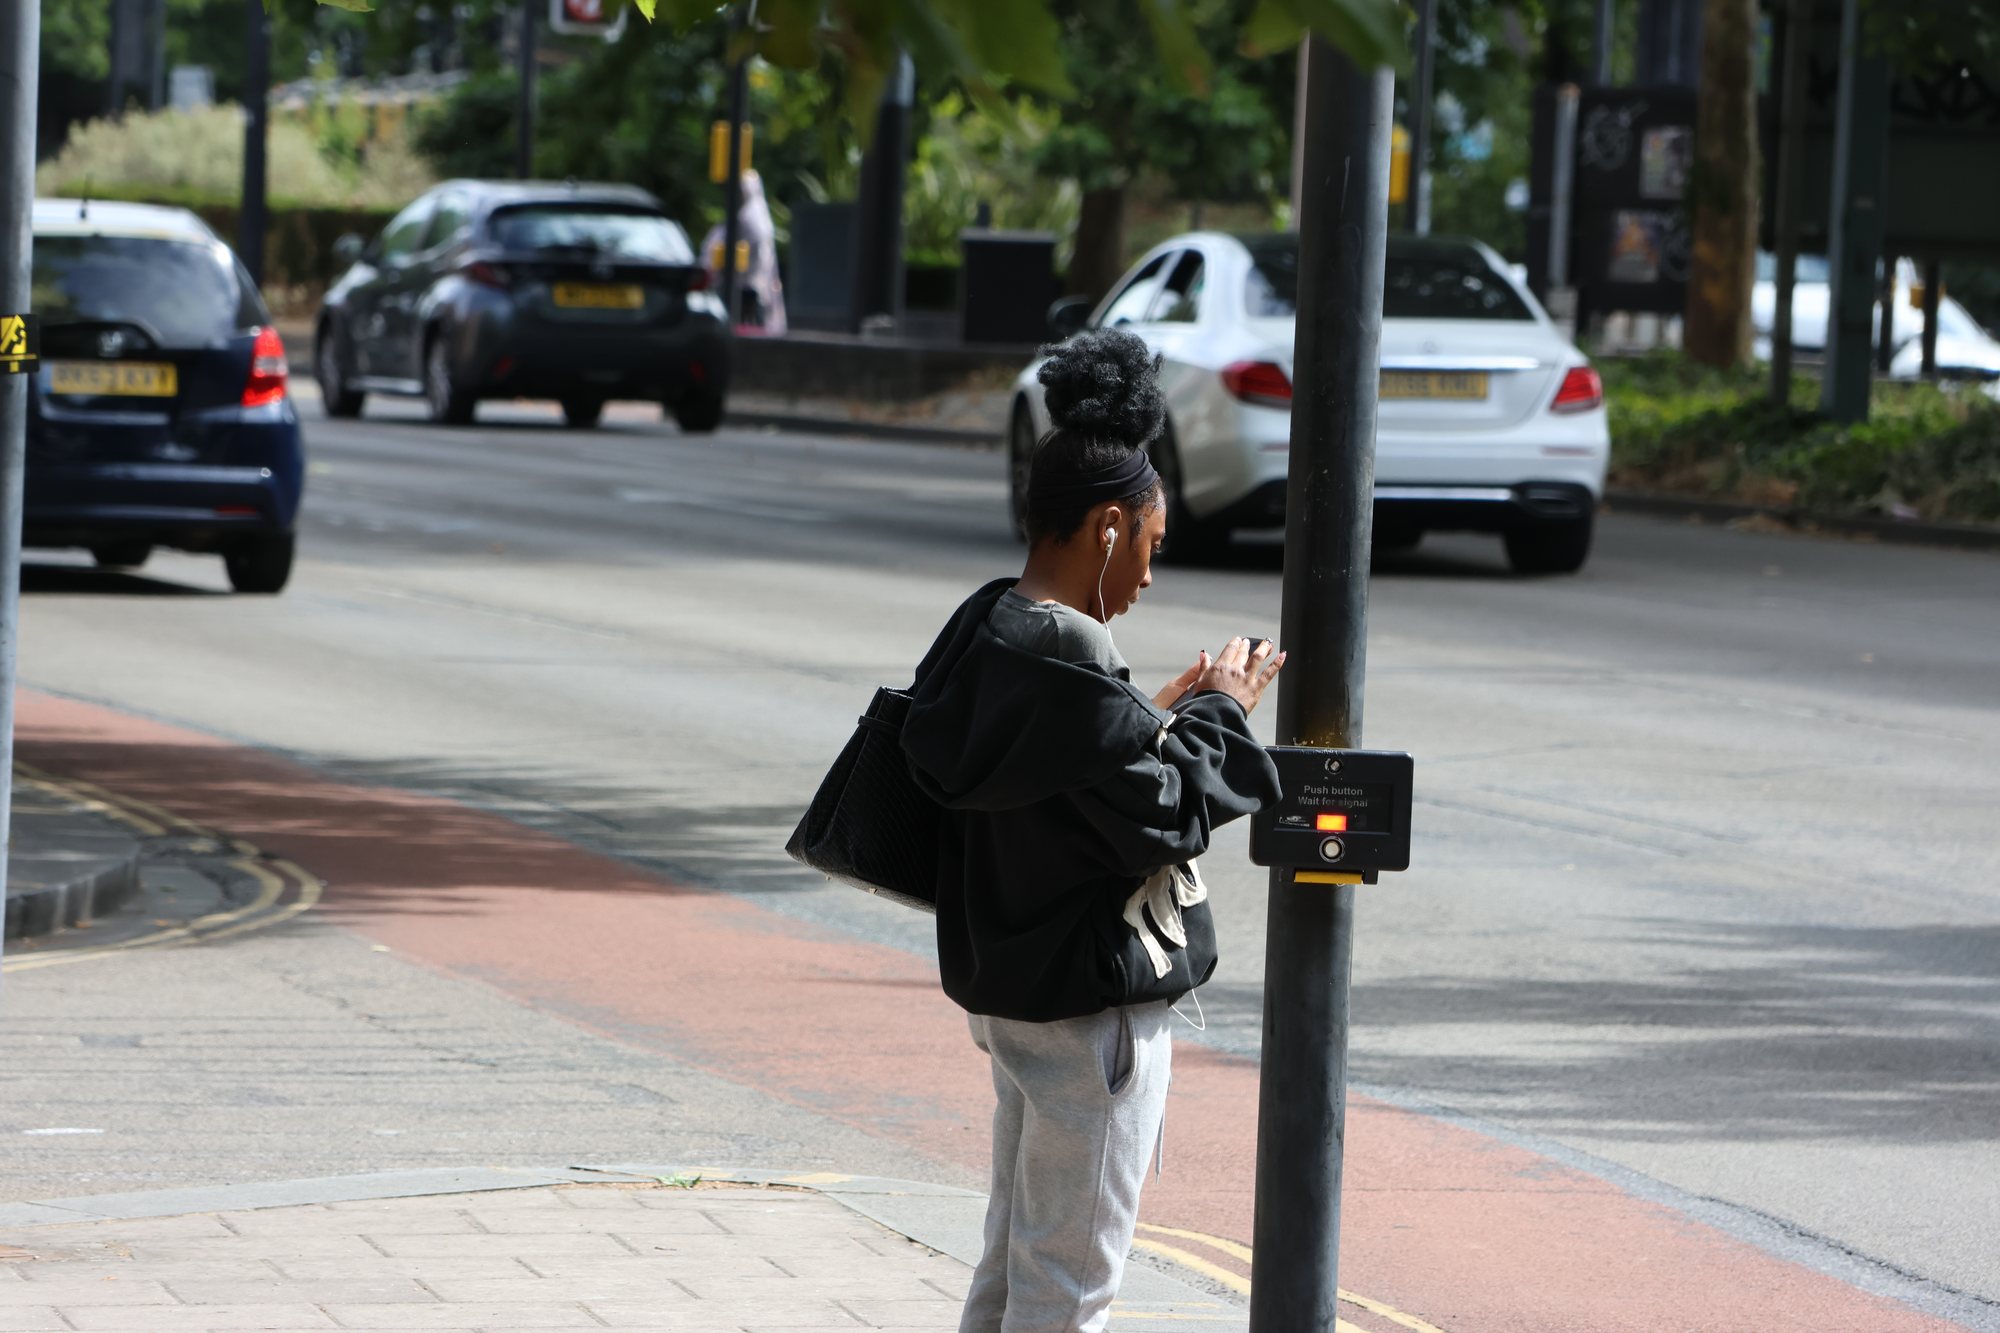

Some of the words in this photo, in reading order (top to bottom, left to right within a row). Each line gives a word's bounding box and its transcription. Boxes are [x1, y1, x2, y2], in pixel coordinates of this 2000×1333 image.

[1303, 784, 1329, 795] Push
[1331, 785, 1363, 796] button
[1297, 796, 1320, 806] Wait
[1321, 797, 1336, 806] for
